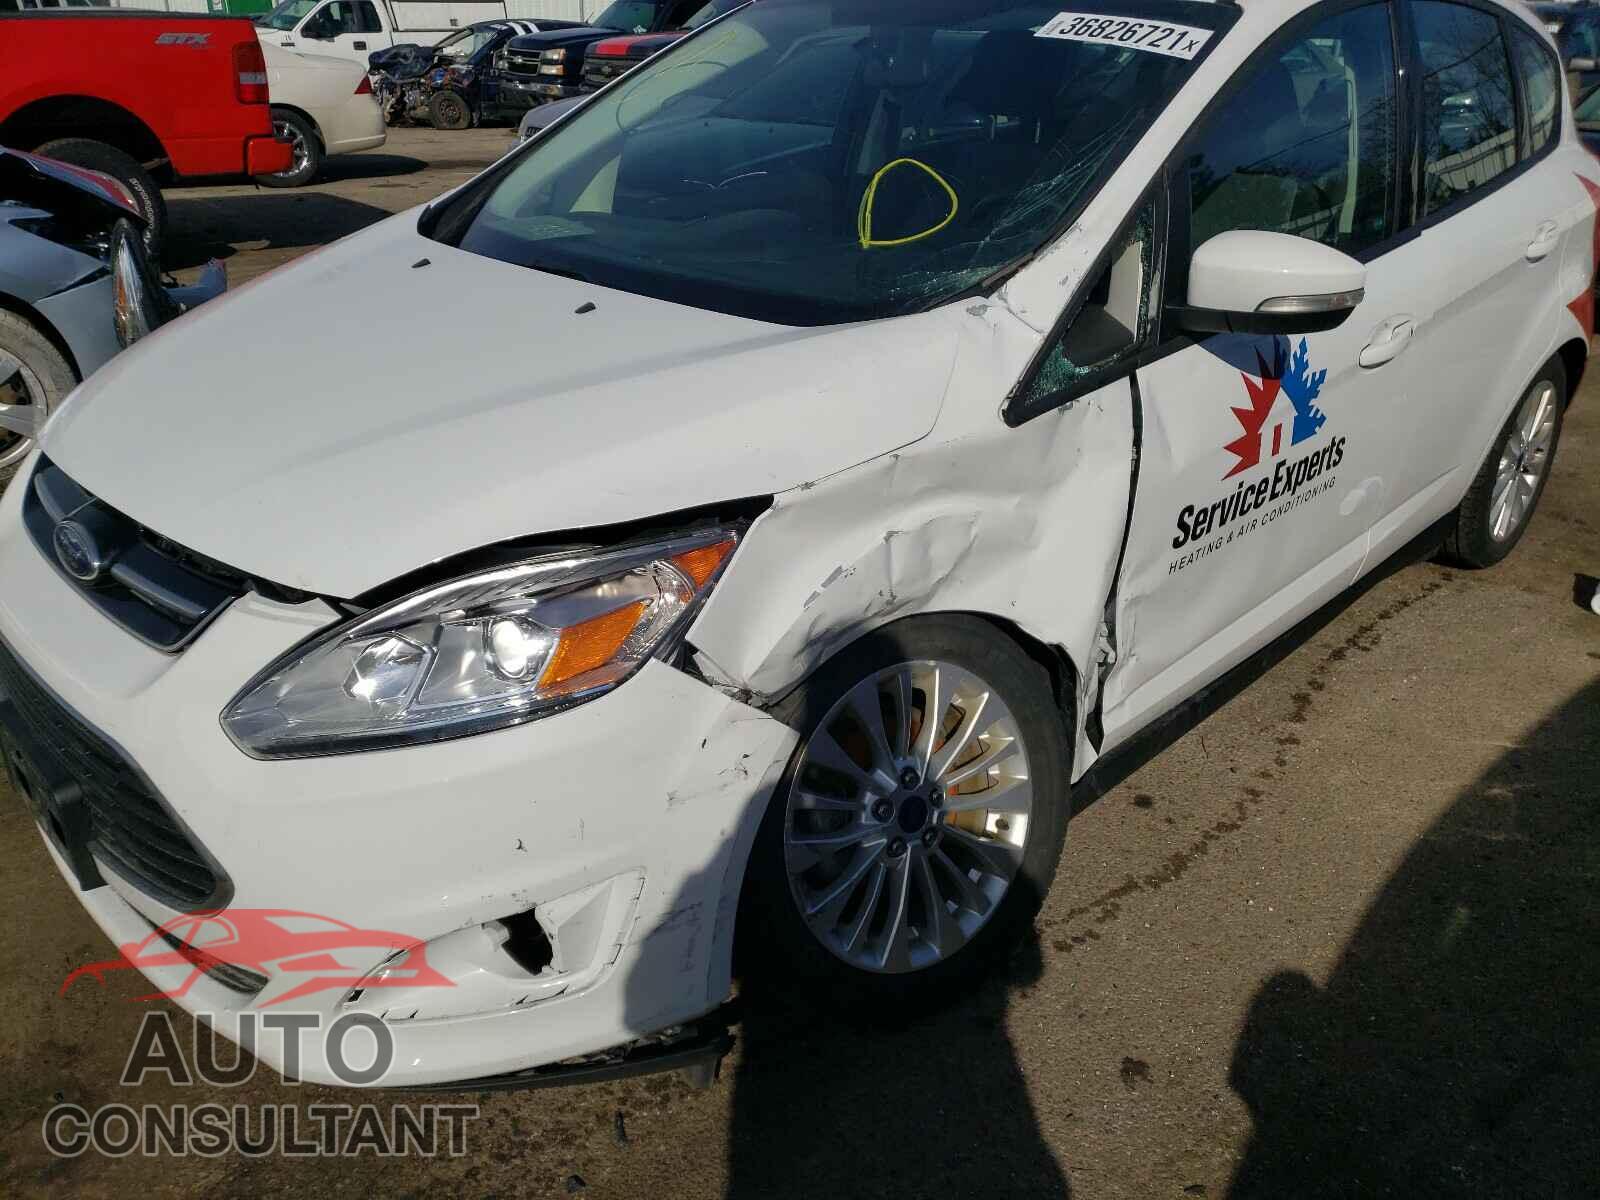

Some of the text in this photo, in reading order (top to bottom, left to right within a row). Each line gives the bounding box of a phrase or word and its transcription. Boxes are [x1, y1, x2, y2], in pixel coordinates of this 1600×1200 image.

[1059, 17, 1189, 51] 36826721
[1168, 475, 1337, 576] HEATING & AIR CONDITIONING
[1172, 435, 1346, 549] Service Experts
